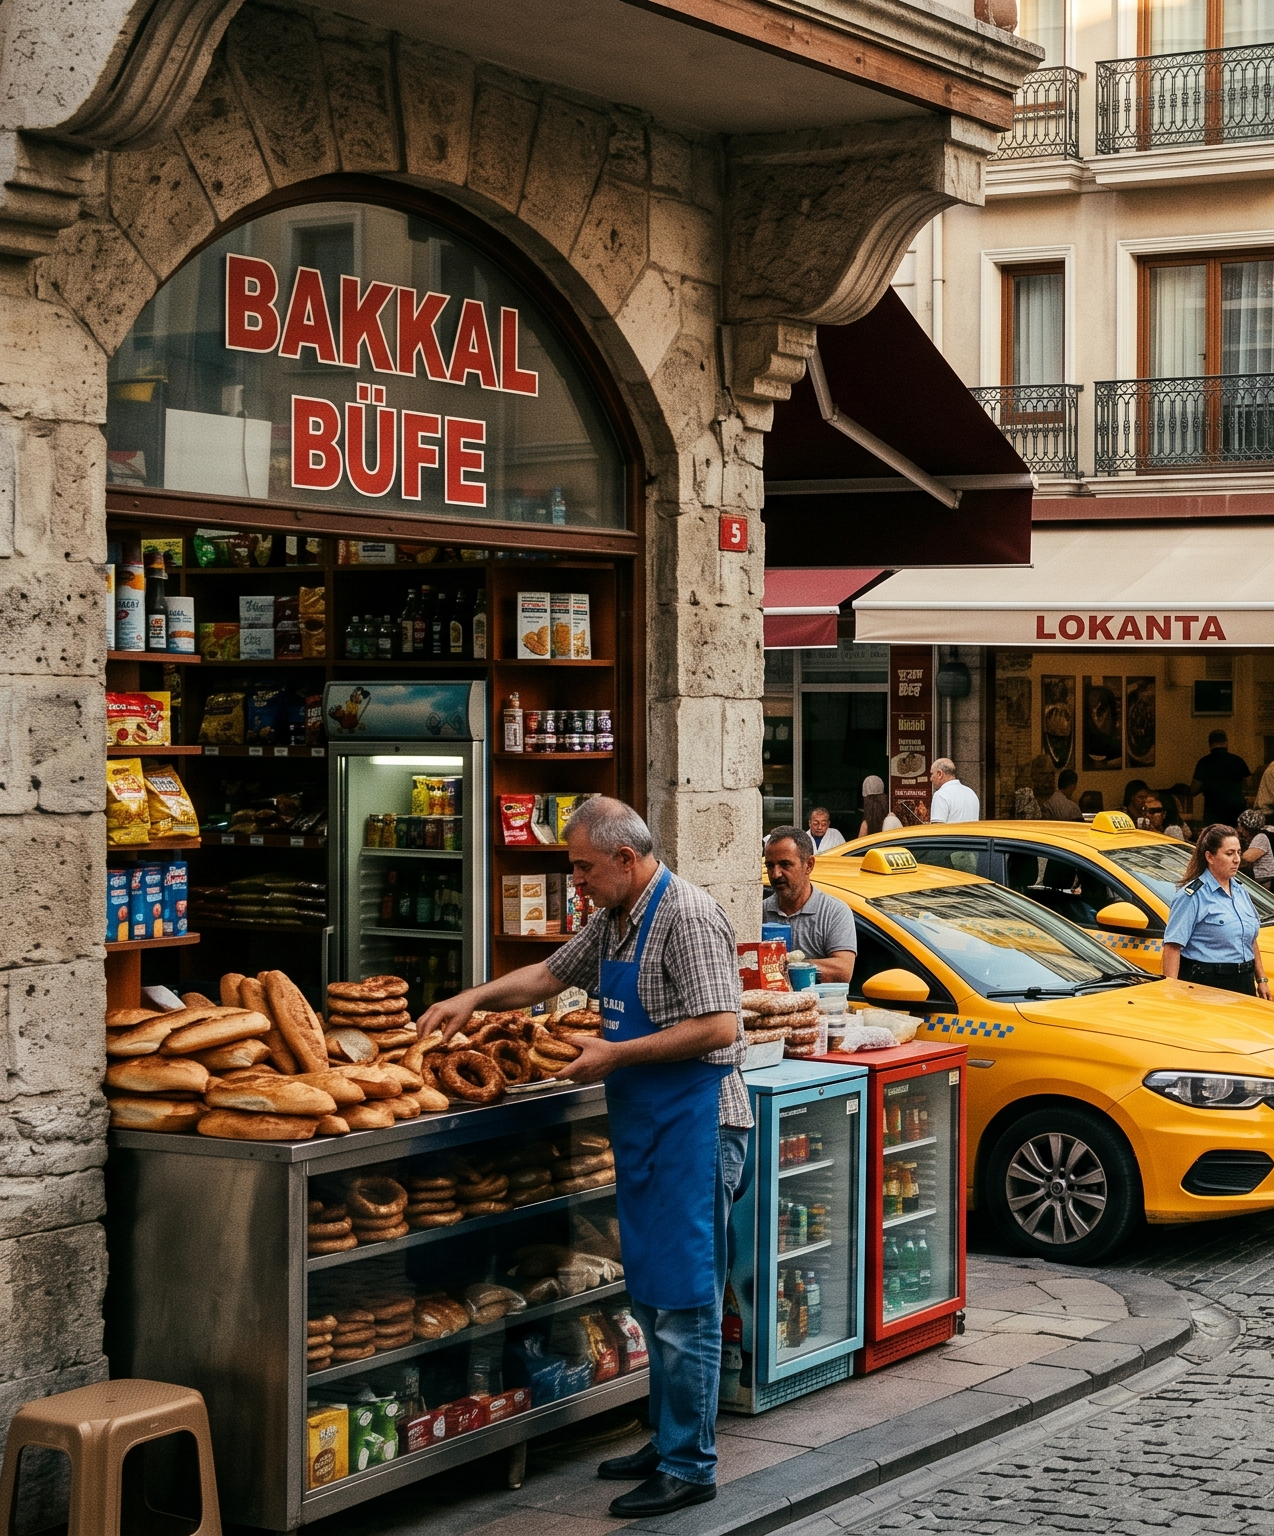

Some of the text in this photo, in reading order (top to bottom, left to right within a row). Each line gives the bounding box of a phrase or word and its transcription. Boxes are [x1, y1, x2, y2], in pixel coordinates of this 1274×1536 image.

[226, 253, 538, 397] BAKKAL
[291, 383, 487, 508] BÜFE
[731, 523, 741, 544] 5
[1035, 614, 1226, 641] LOKANTA
